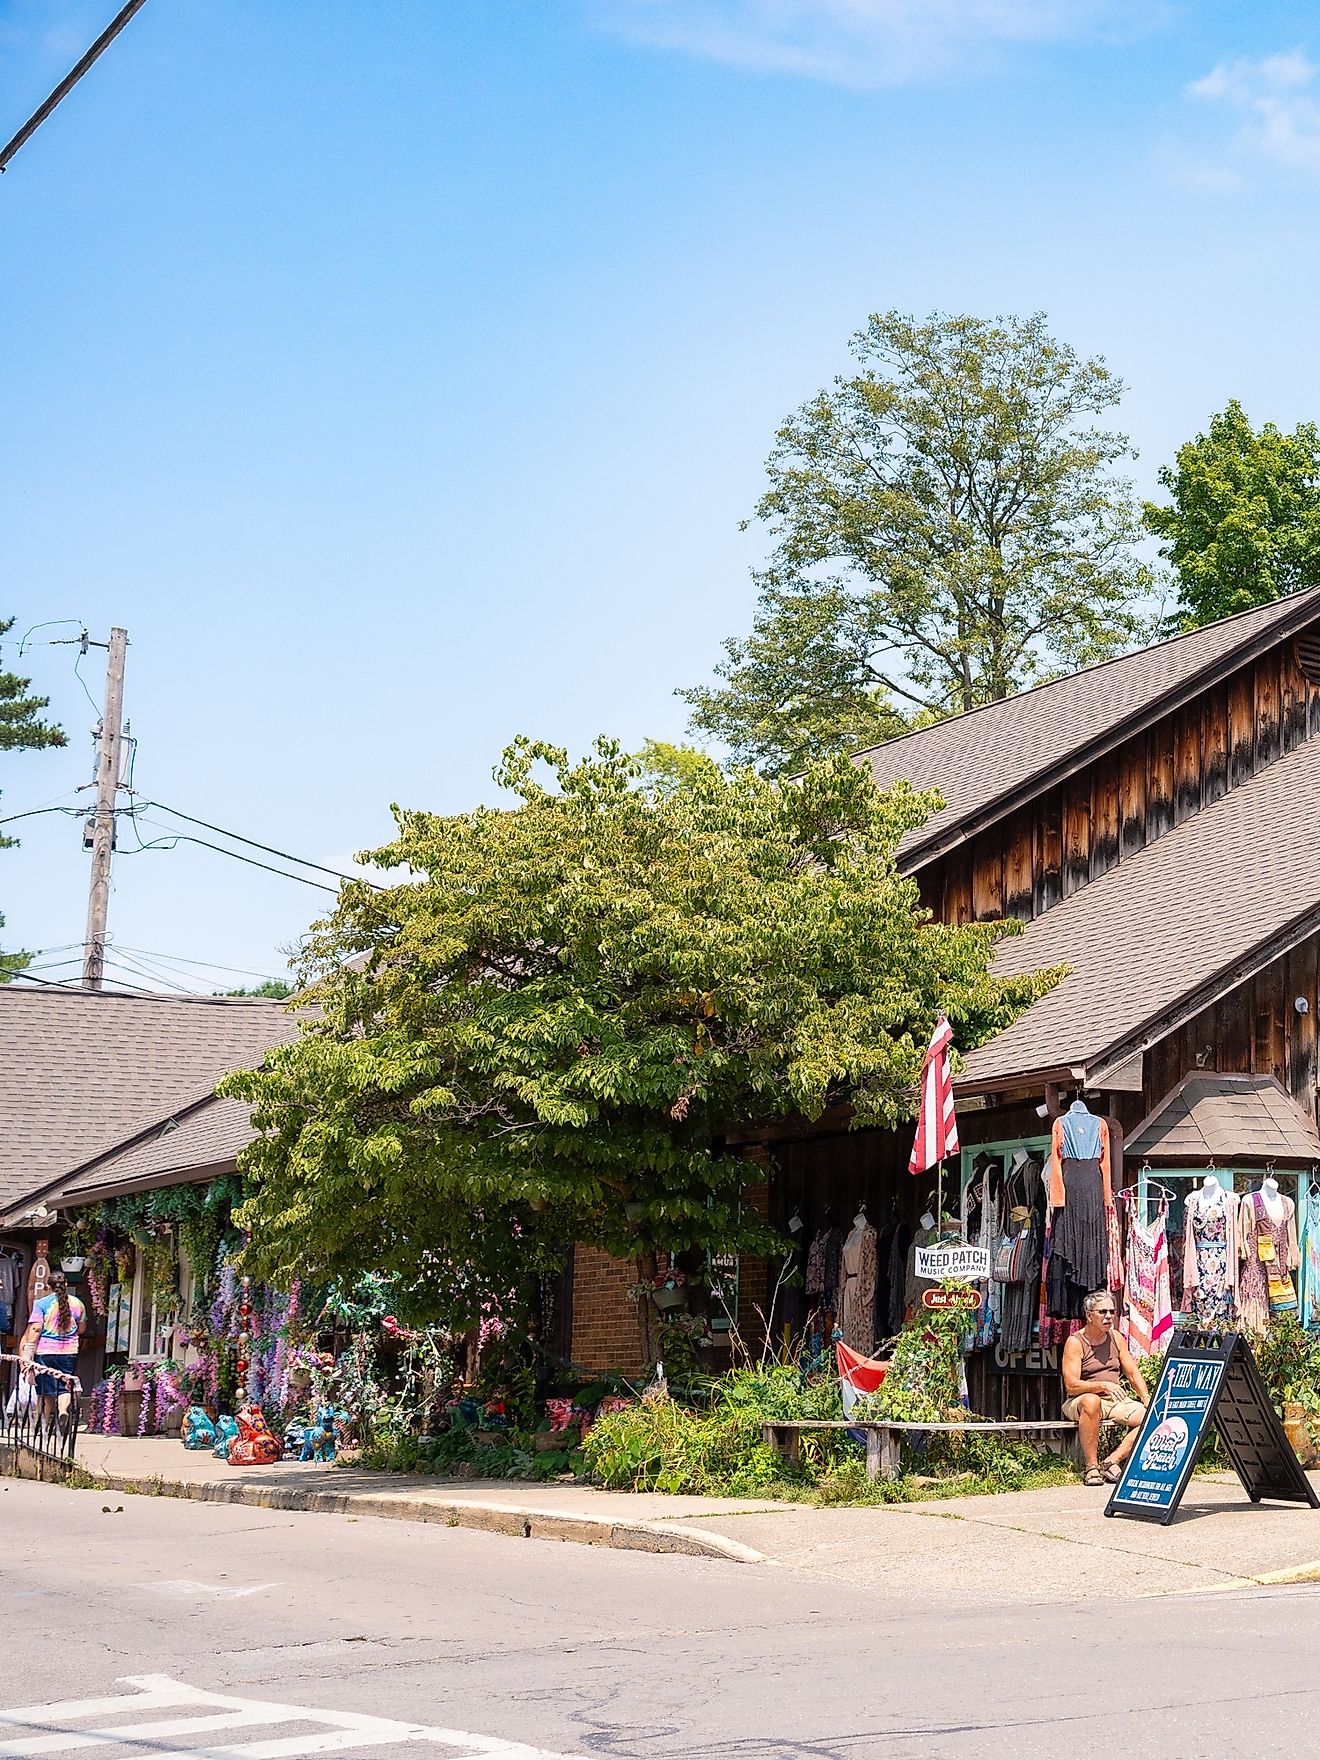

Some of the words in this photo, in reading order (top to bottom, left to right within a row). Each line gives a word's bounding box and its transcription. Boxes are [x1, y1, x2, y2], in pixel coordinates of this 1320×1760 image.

[919, 1251, 949, 1267] WEED
[952, 1250, 987, 1266] PATCH
[920, 1266, 945, 1275] MUSIC
[947, 1264, 987, 1274] COMPANY
[34, 1264, 46, 1296] OP
[930, 1293, 947, 1304] Just
[1172, 1363, 1197, 1388] THIS
[1194, 1364, 1221, 1390] WAY
[1150, 1431, 1186, 1452] Weed
